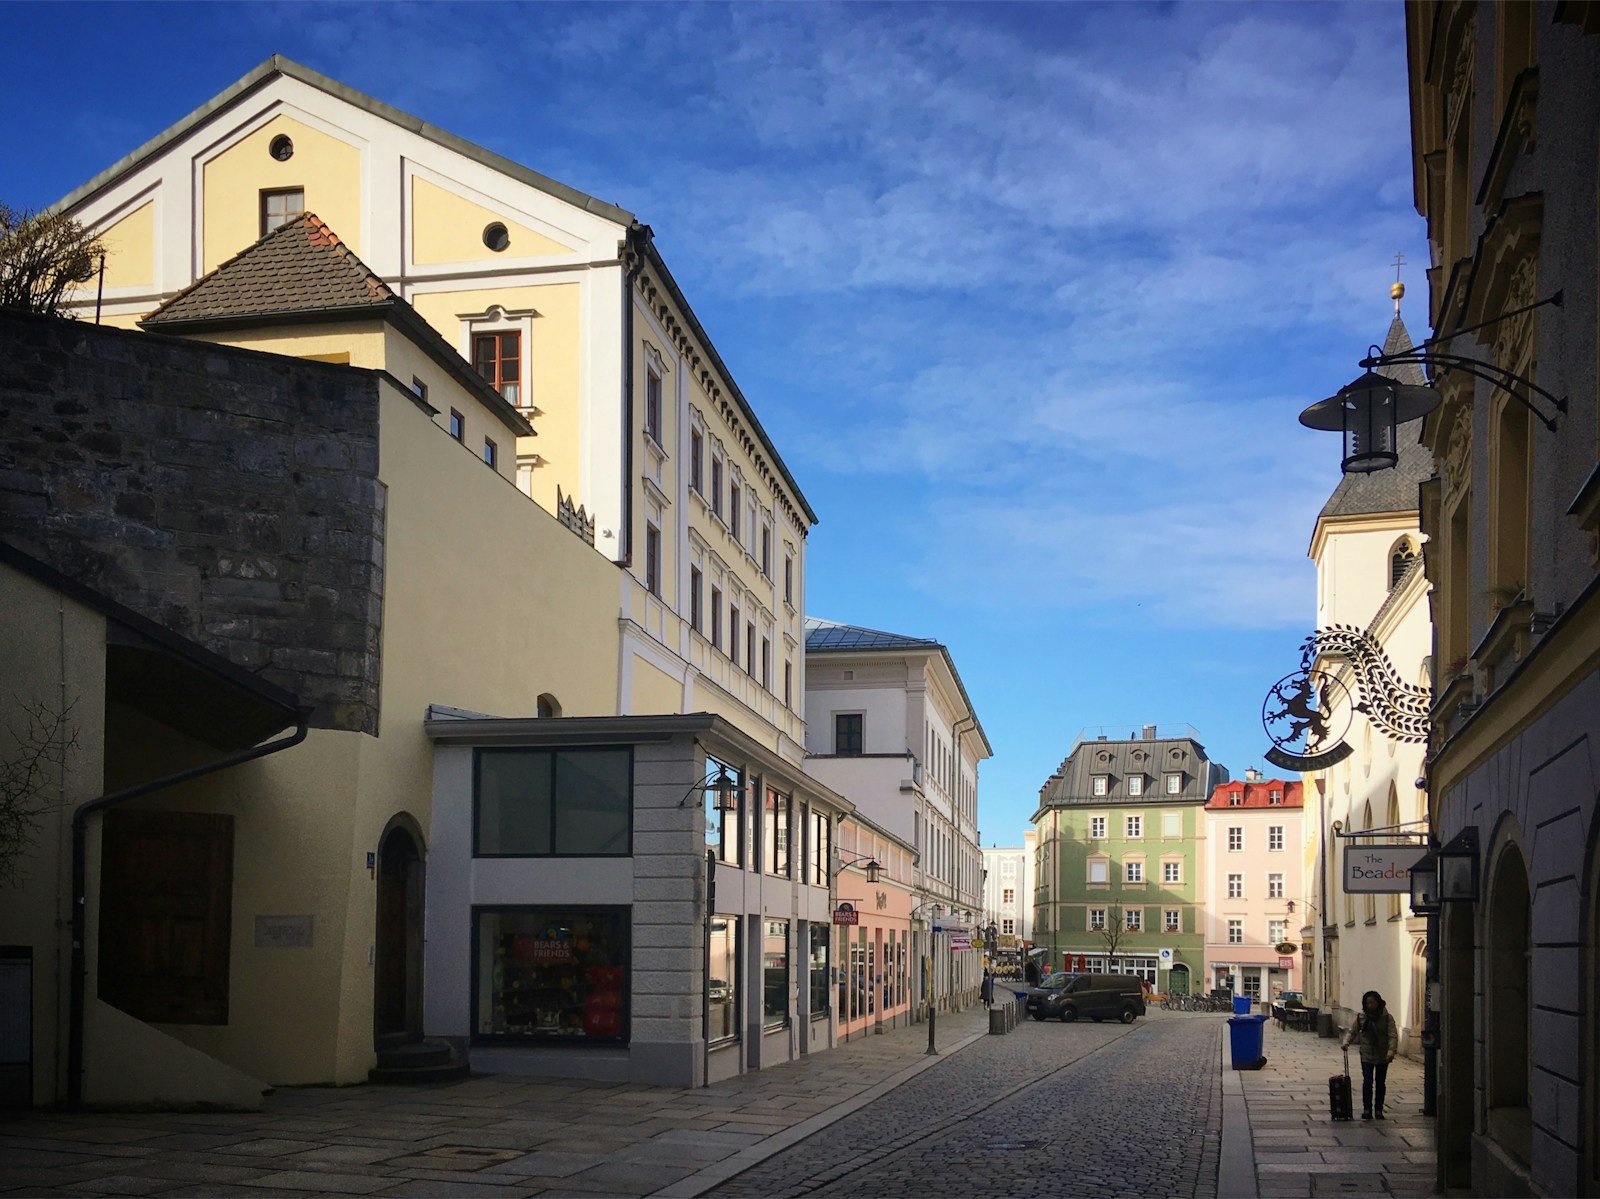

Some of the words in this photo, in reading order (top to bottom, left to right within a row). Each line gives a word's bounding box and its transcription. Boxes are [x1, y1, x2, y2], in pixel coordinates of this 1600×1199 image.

[1365, 853, 1383, 864] The
[1352, 862, 1412, 879] Beader
[534, 940, 562, 949] BEARS
[562, 941, 570, 949] &
[534, 949, 570, 958] FRIENDS
